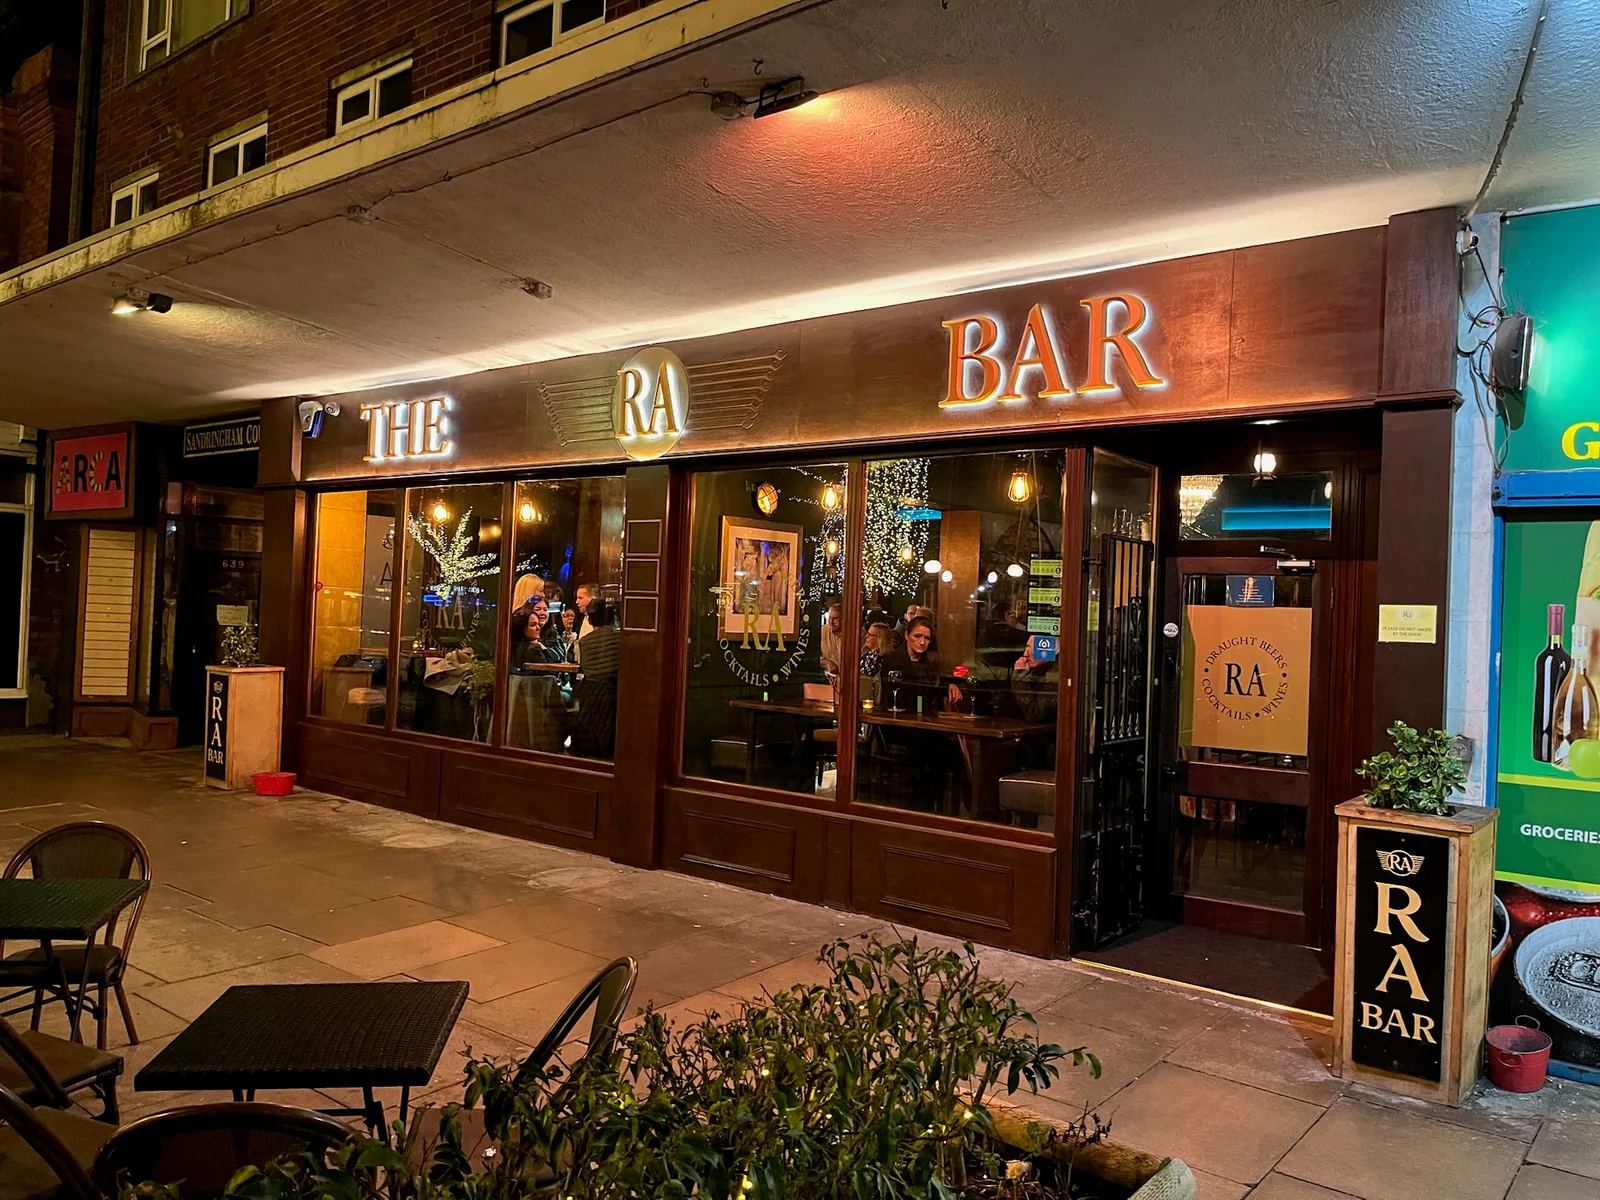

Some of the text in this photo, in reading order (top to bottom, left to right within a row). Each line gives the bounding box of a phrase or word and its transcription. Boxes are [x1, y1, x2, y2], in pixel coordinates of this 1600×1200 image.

[360, 293, 1165, 462] THE RA BAR
[186, 426, 243, 451] SANDRINGHAM
[56, 450, 122, 494] ARCA
[222, 559, 245, 569] 639
[740, 600, 787, 652] RA
[780, 628, 810, 677] WINES
[1206, 636, 1288, 669] DRAUGHT BEERS
[1224, 662, 1267, 697] RA
[1201, 678, 1288, 720] COCKTAILS WINES
[207, 748, 224, 765] BAR
[1520, 823, 1600, 845] GROCERIE
[1388, 855, 1412, 872] RA
[1360, 1001, 1437, 1044] BAR
